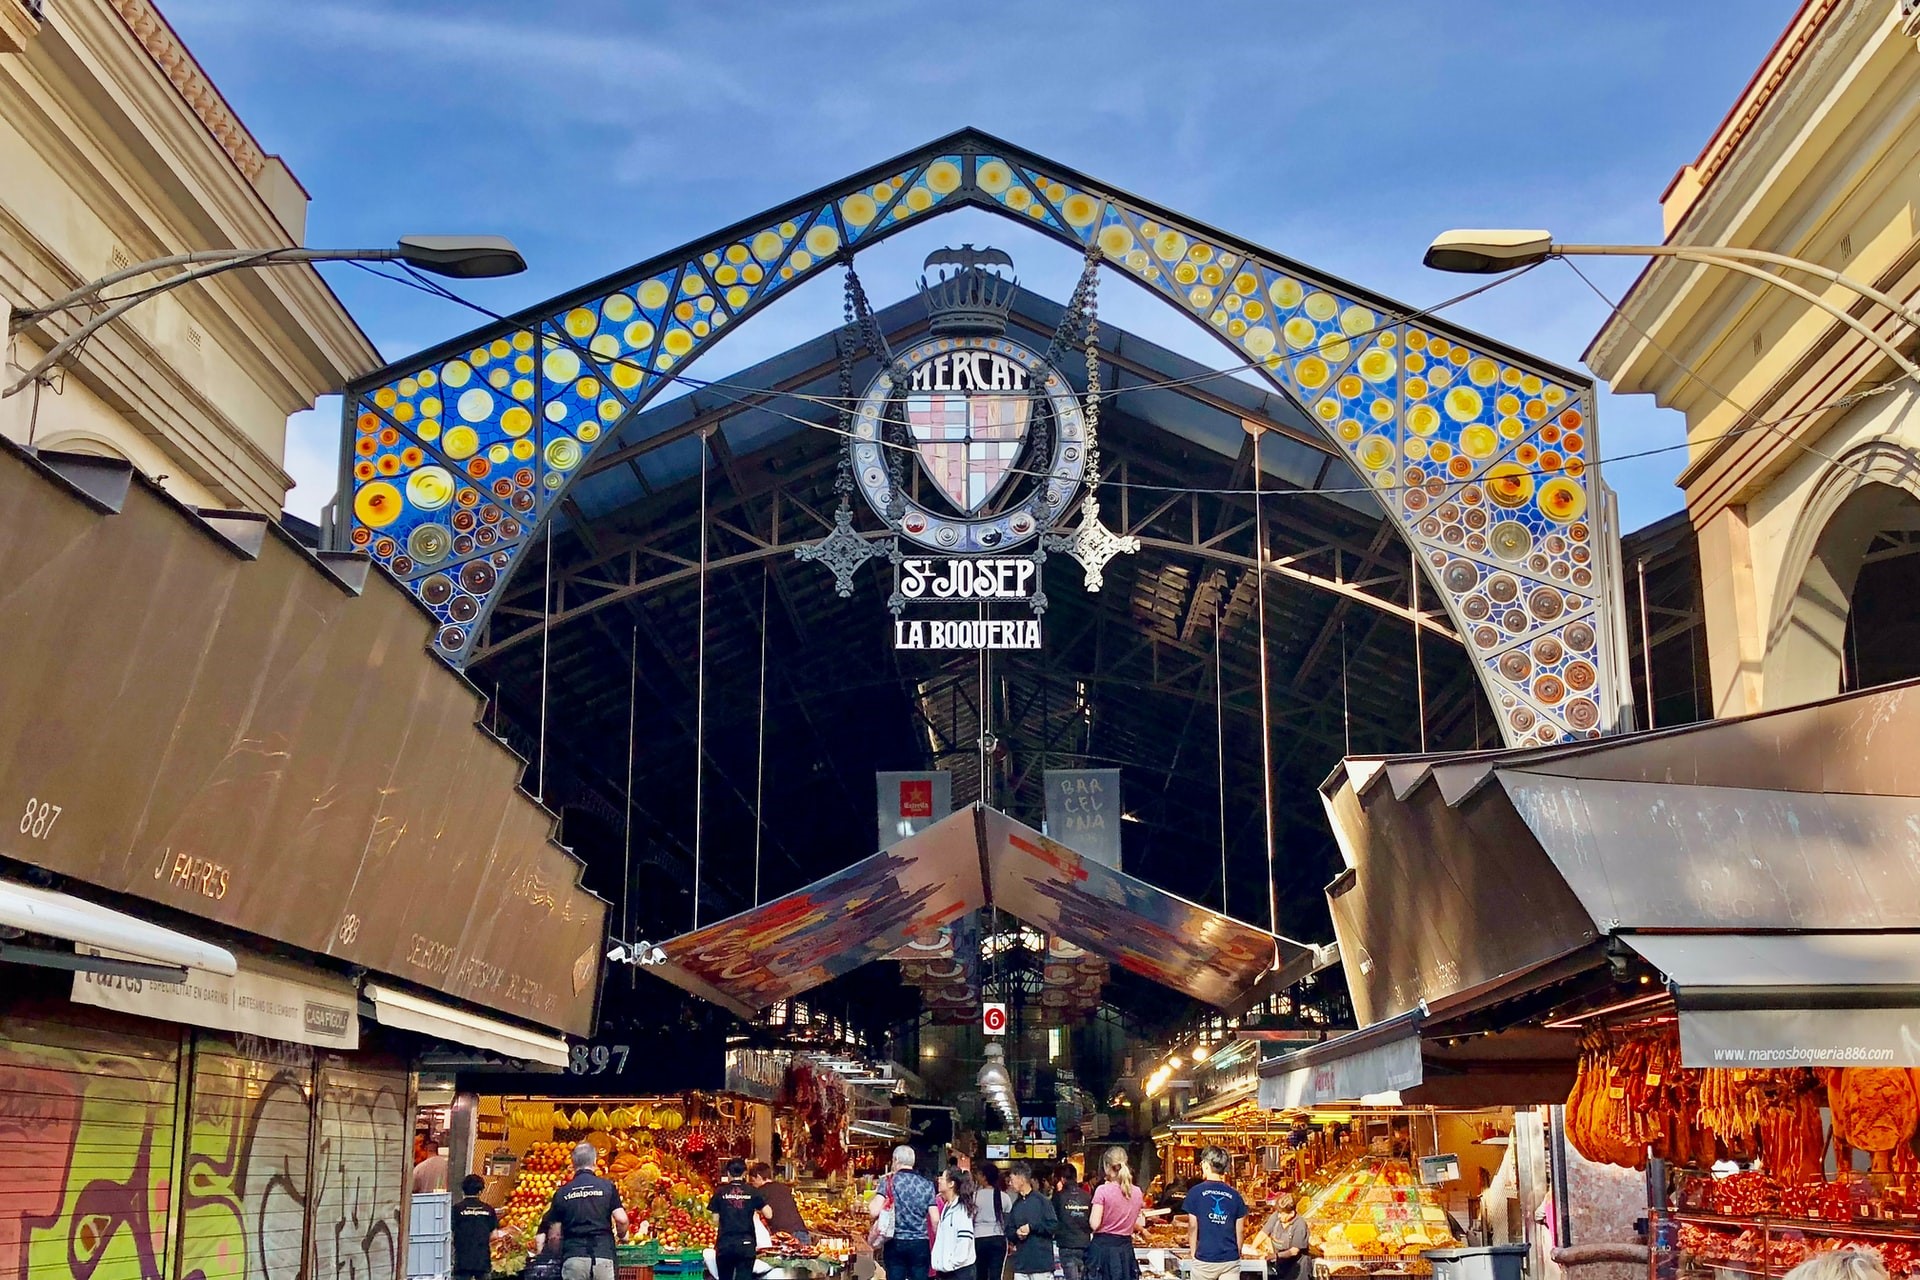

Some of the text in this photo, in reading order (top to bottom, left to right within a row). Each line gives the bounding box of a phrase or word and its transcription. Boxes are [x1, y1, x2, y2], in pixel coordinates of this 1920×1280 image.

[912, 352, 1027, 391] MERCAT
[932, 560, 1035, 598] JOSEP
[895, 620, 1042, 649] LA BOQUERIA
[21, 797, 62, 840] 887
[154, 847, 230, 900] J FARRES
[339, 914, 361, 944] 888
[990, 1012, 1000, 1026] 6
[570, 1045, 630, 1075] 897
